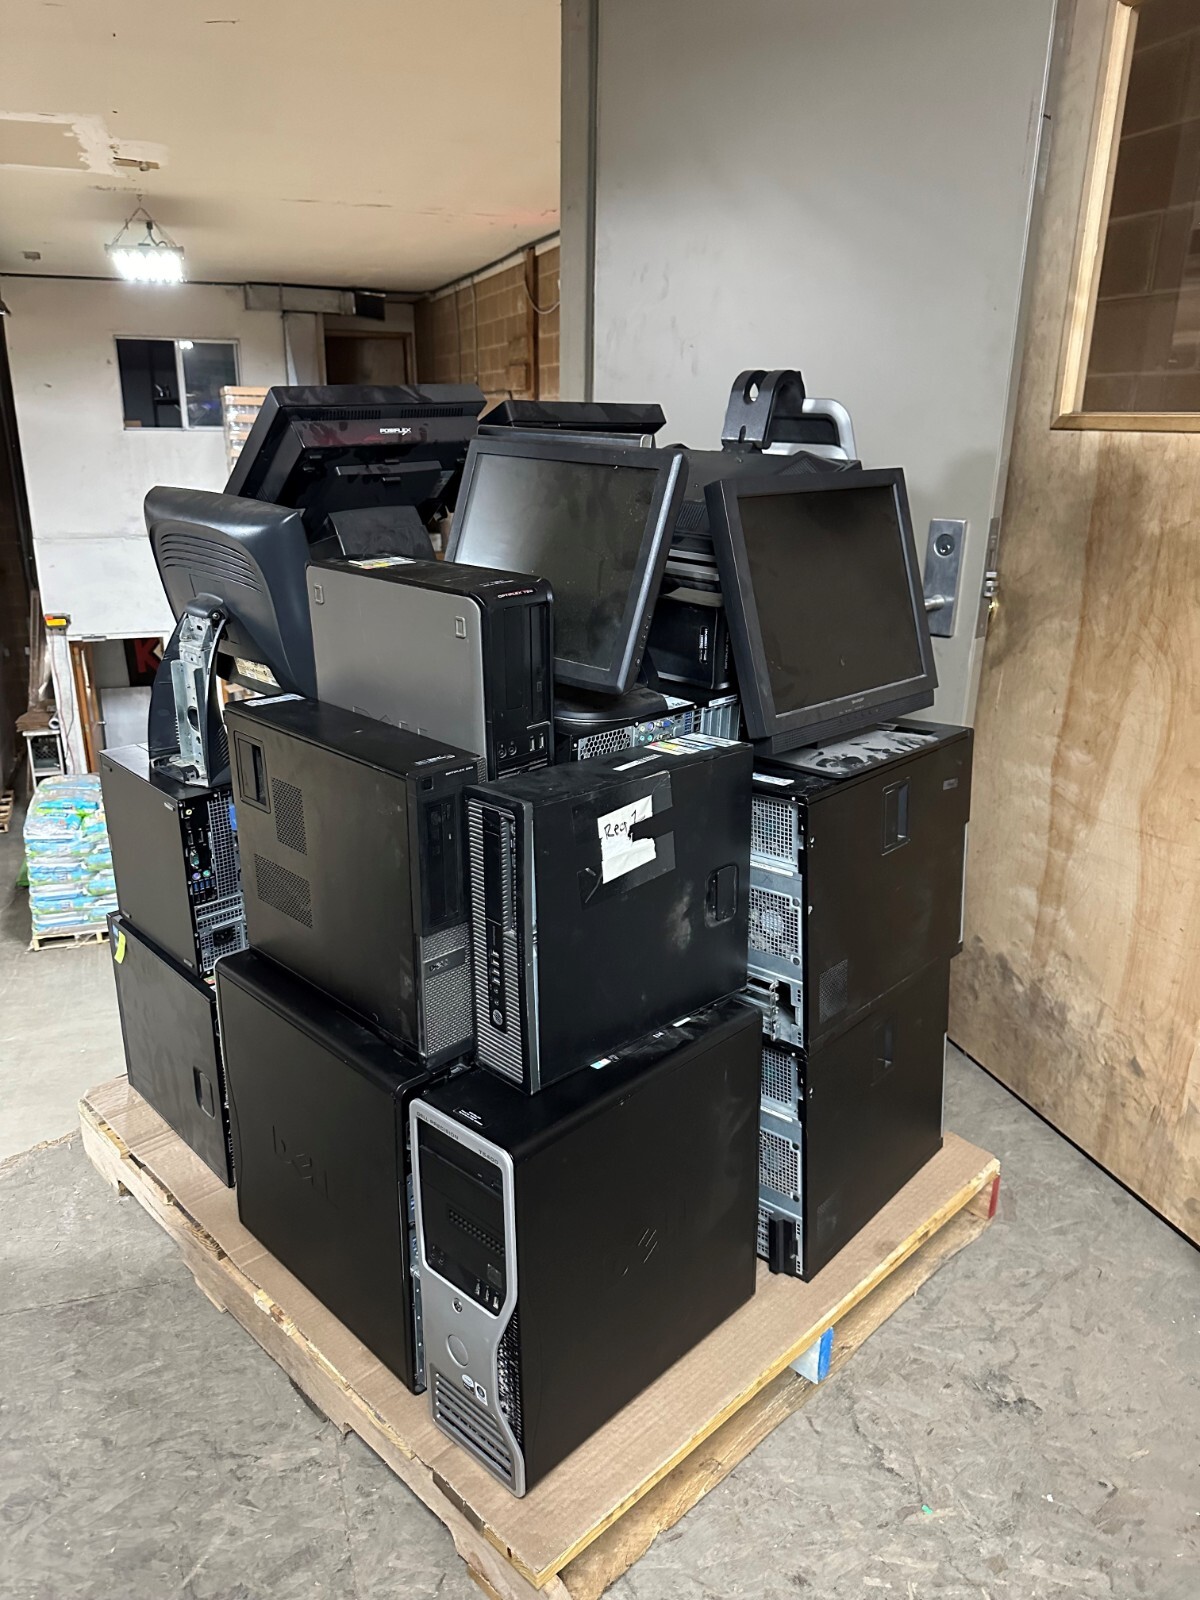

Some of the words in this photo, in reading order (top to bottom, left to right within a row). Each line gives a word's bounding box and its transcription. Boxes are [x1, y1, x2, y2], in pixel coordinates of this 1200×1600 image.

[380, 427, 411, 435] POSIFLEX
[416, 1111, 429, 1122] DELL
[429, 1119, 459, 1140] PRECISION
